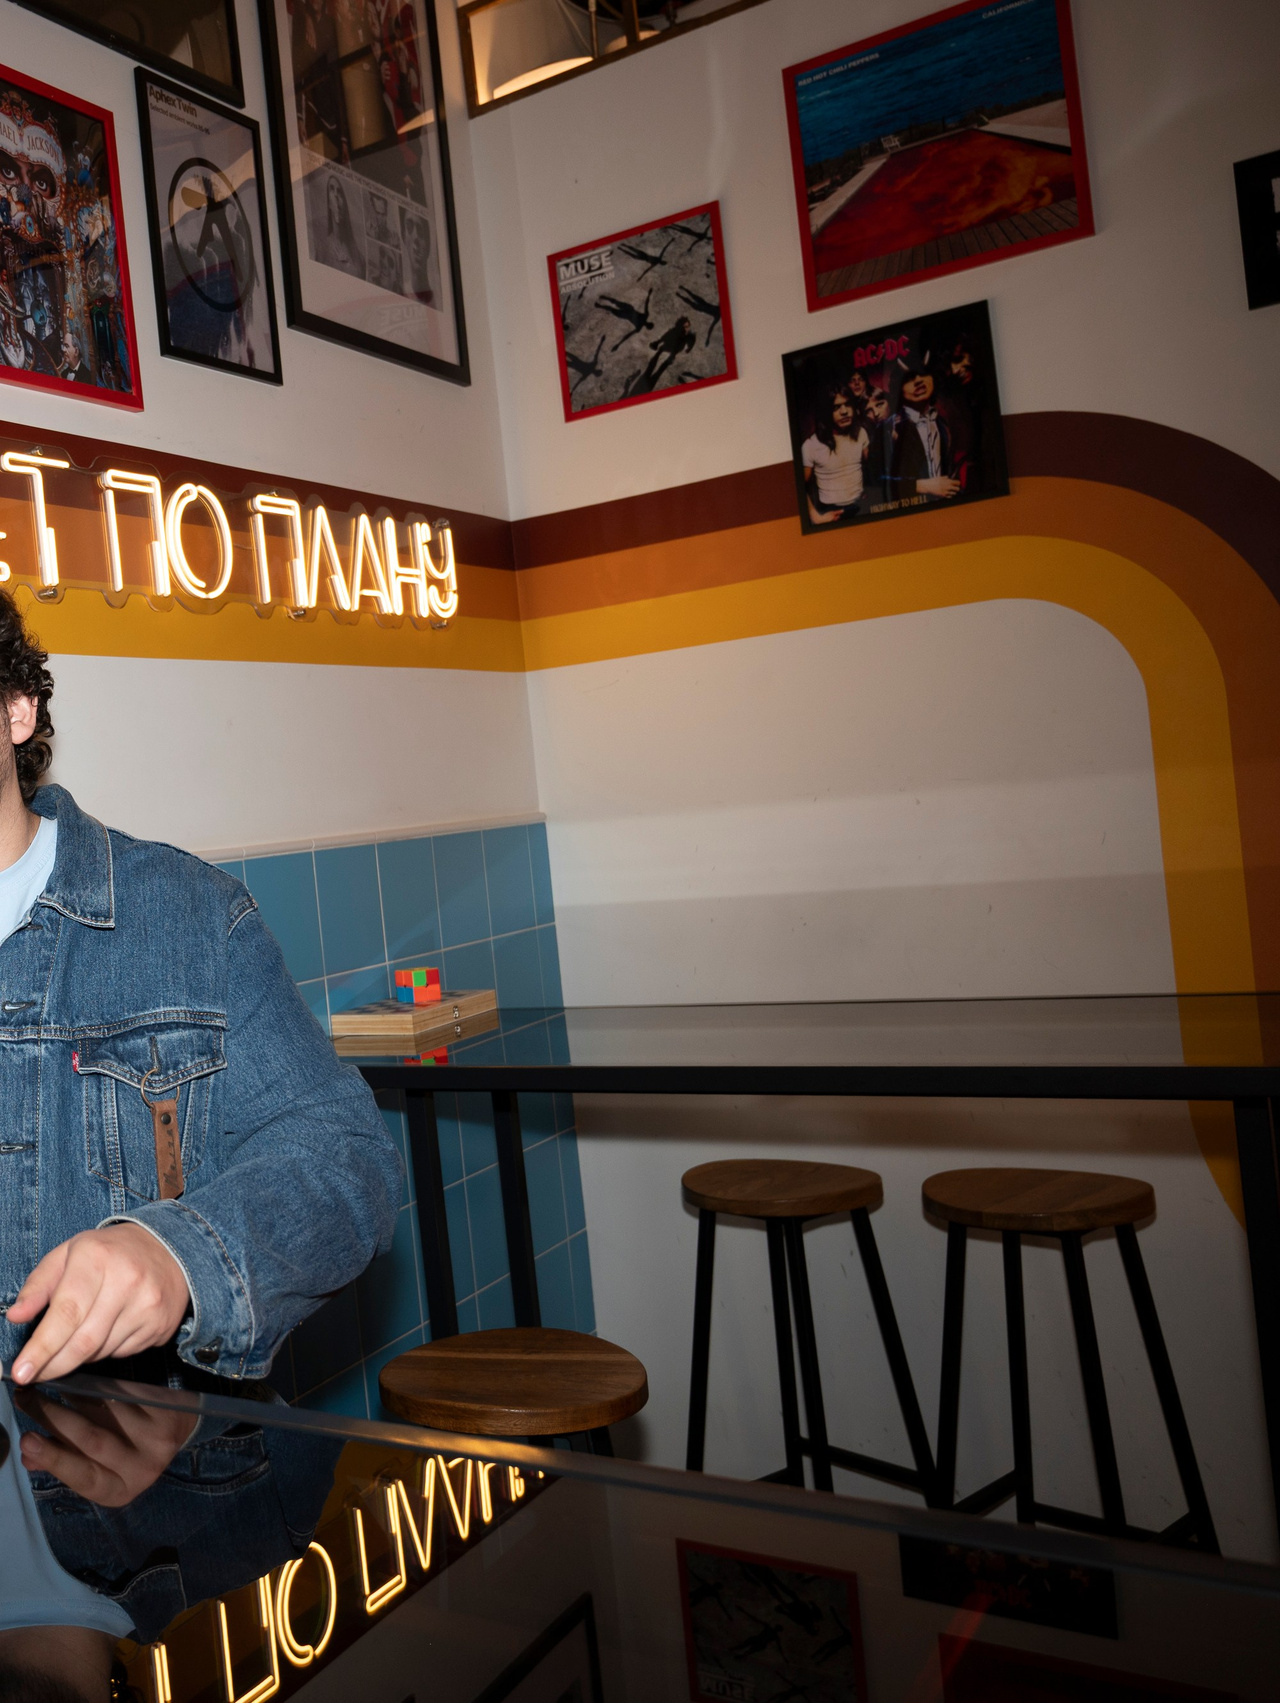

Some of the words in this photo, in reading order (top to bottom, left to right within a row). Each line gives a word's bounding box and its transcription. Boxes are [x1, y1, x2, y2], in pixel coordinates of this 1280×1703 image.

[149, 85, 177, 108] Aphex
[177, 97, 198, 118] Twin
[27, 135, 60, 165] JACKSON
[560, 250, 614, 280] MUSE
[560, 271, 616, 294] ABSOLUTION
[901, 498, 910, 508] TO
[98, 467, 233, 599] ПО
[250, 493, 459, 620] ПЛАНУ
